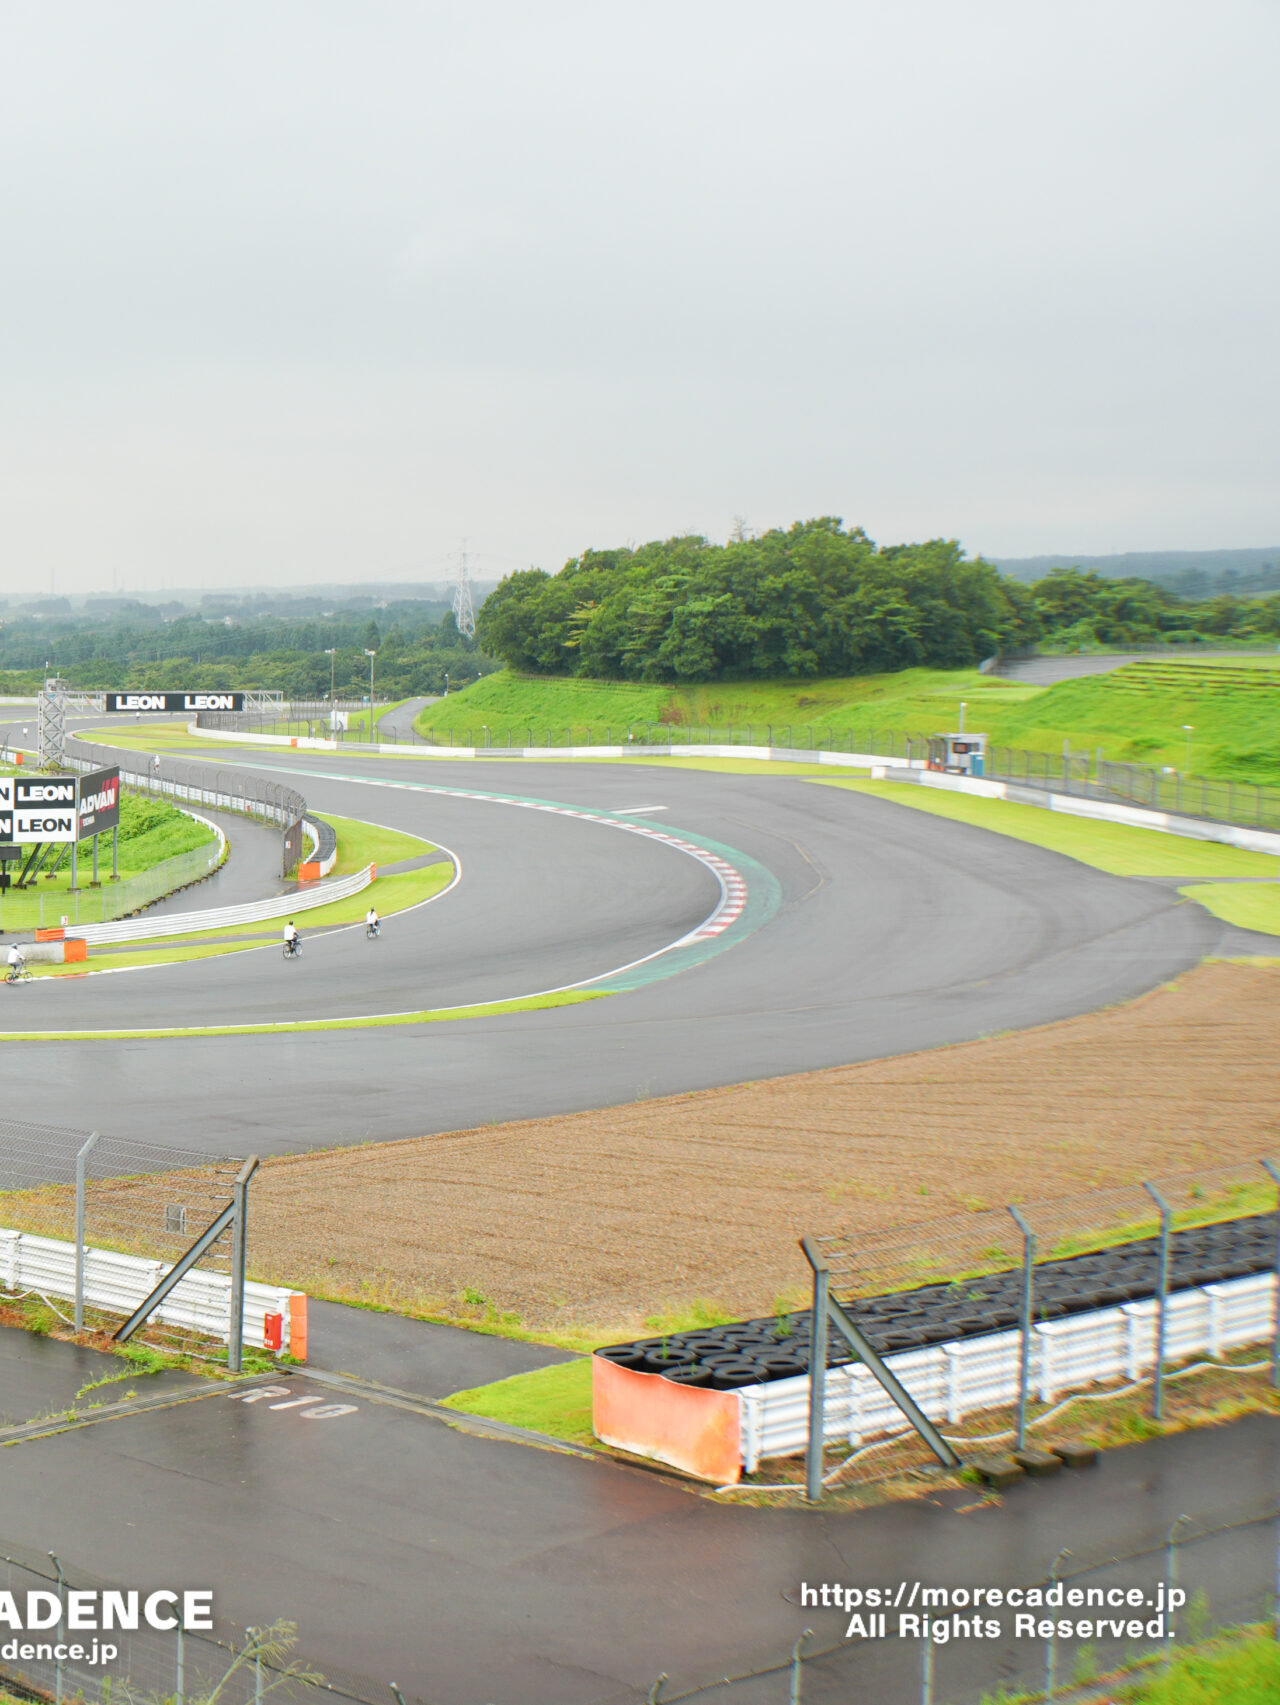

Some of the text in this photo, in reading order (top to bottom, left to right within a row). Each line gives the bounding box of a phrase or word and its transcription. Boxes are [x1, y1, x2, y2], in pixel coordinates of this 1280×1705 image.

[116, 695, 234, 710] LEON LEON
[17, 785, 74, 801] LEON
[79, 788, 115, 816] ADVAN
[17, 818, 72, 833] LEON
[227, 1385, 360, 1419] R10
